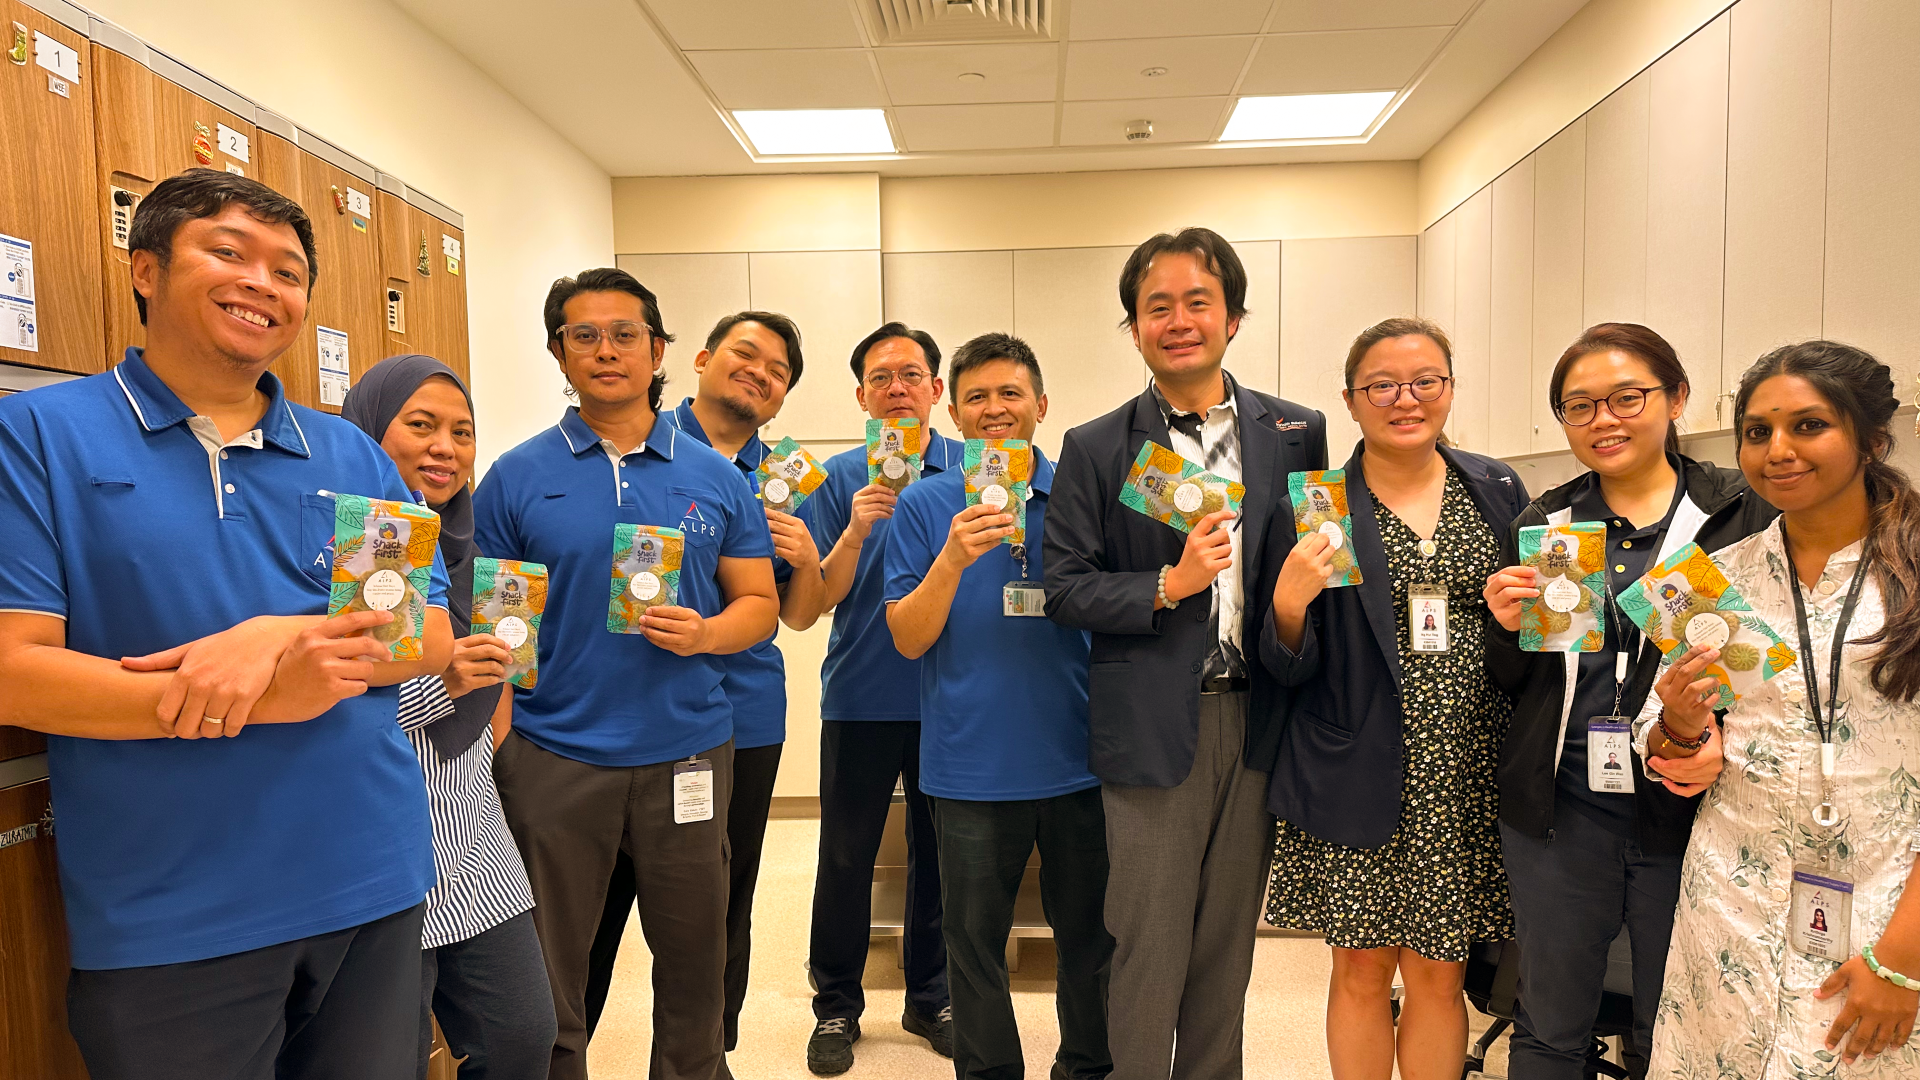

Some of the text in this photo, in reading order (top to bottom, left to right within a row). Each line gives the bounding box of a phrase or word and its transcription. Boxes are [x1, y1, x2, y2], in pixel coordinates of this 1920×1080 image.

[54, 50, 61, 68] 1
[230, 136, 237, 152] 2
[356, 196, 362, 210] 3
[450, 242, 454, 253] 4
[679, 520, 715, 536] ALPS
[372, 539, 402, 549] snack
[371, 549, 402, 559] first
[1547, 551, 1572, 561] snack
[1547, 560, 1572, 568] first
[501, 591, 523, 599] snack
[501, 598, 523, 606] first
[1665, 590, 1690, 611] snack
[1671, 597, 1693, 617] first
[1810, 899, 1829, 908] ALPS
